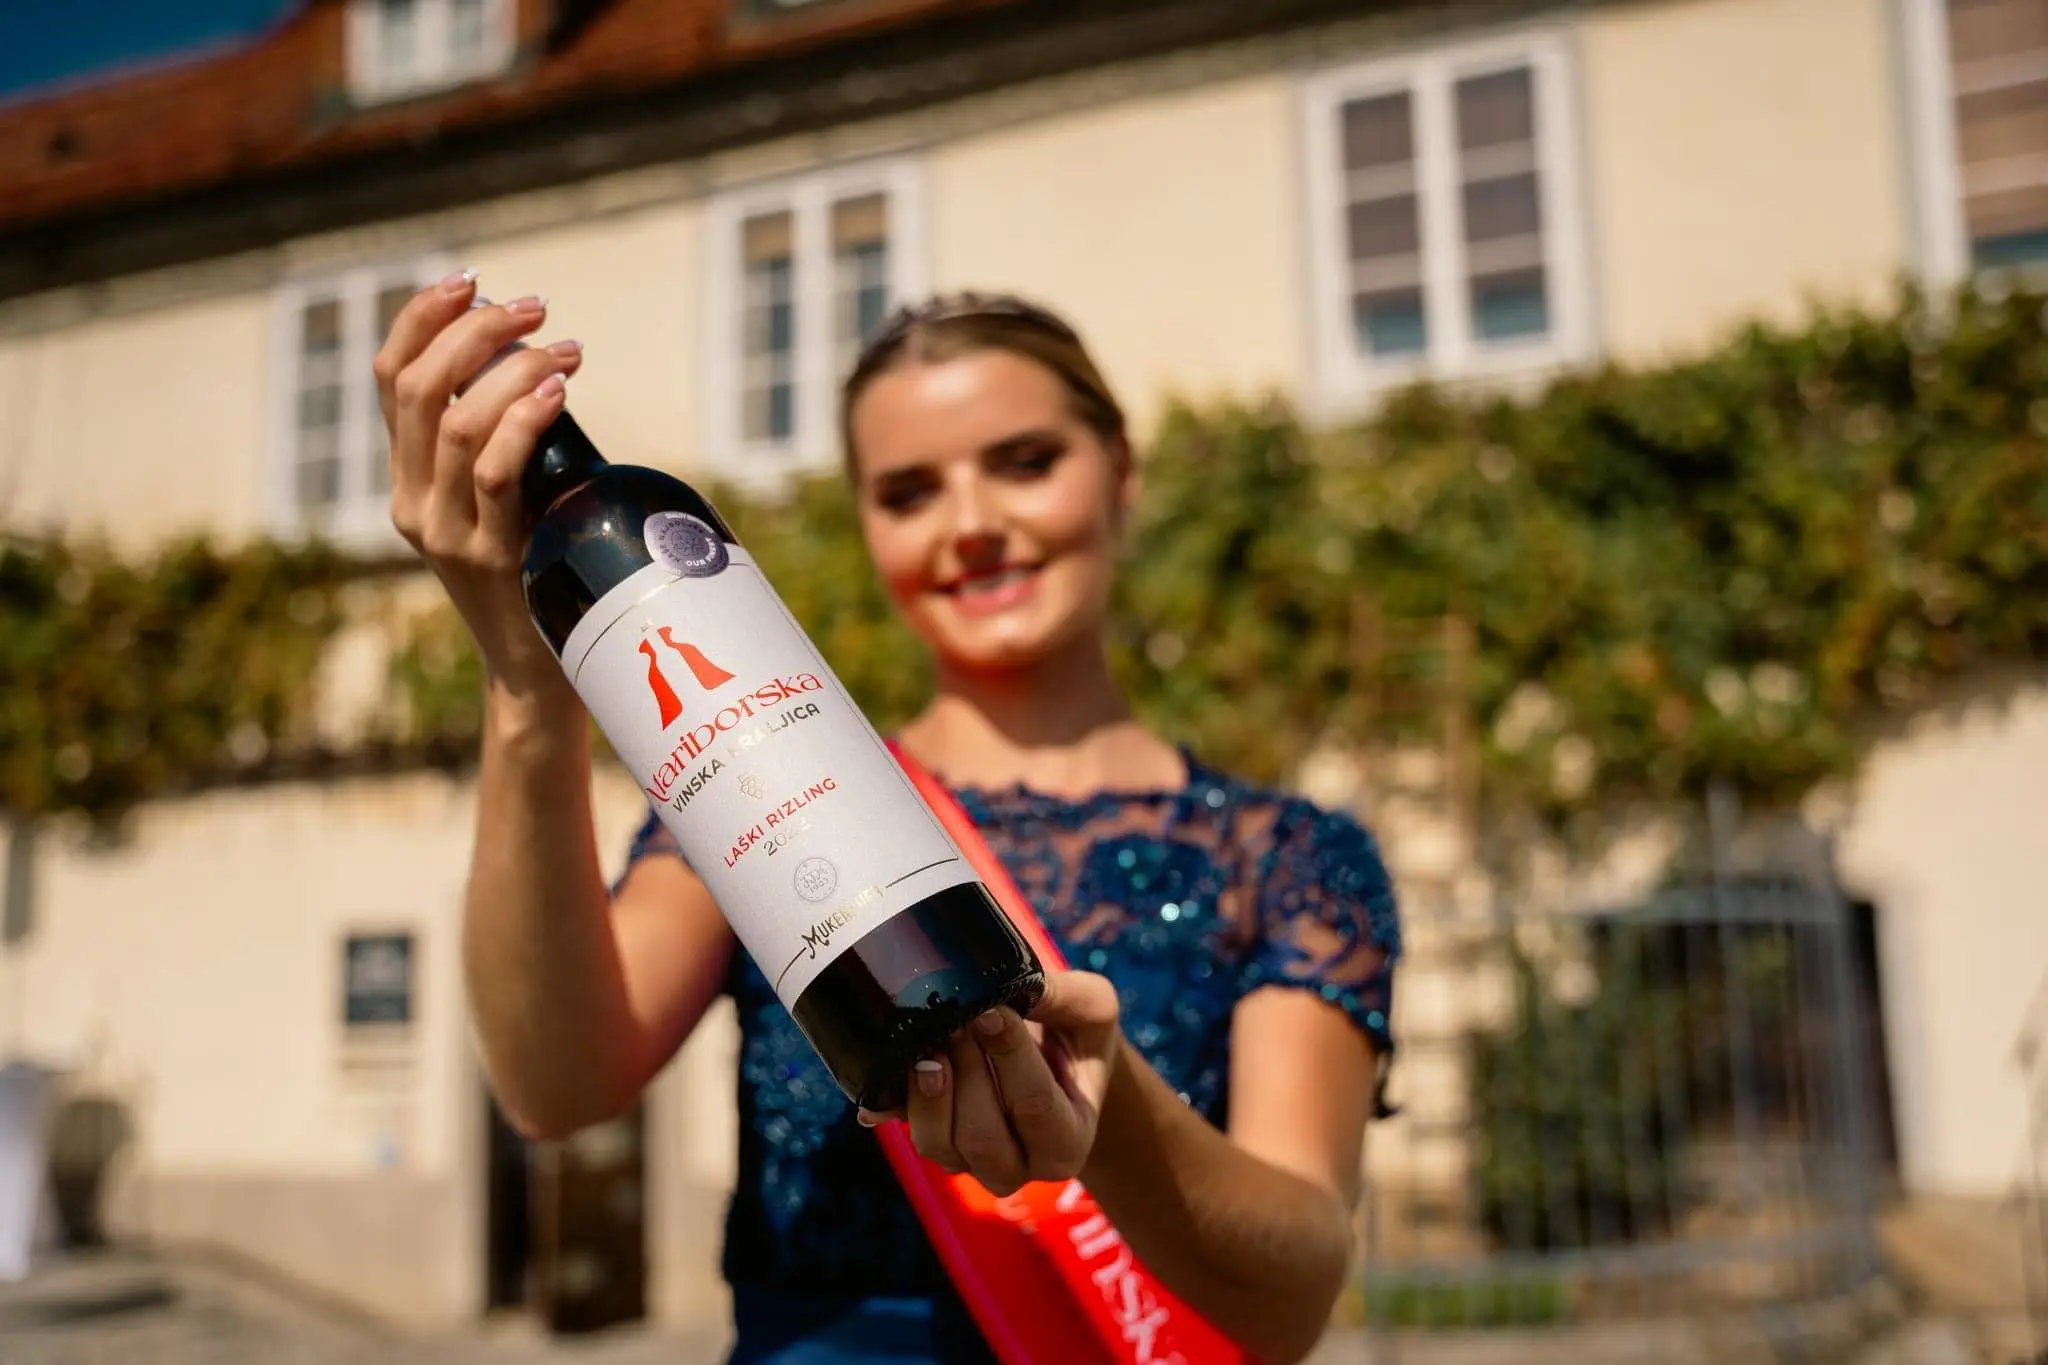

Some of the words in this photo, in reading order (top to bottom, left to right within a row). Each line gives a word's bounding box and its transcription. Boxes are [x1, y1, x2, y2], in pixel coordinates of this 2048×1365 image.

[673, 758, 725, 813] VINSKA
[724, 824, 765, 867] LAŠKI
[765, 778, 837, 828] RIZLING
